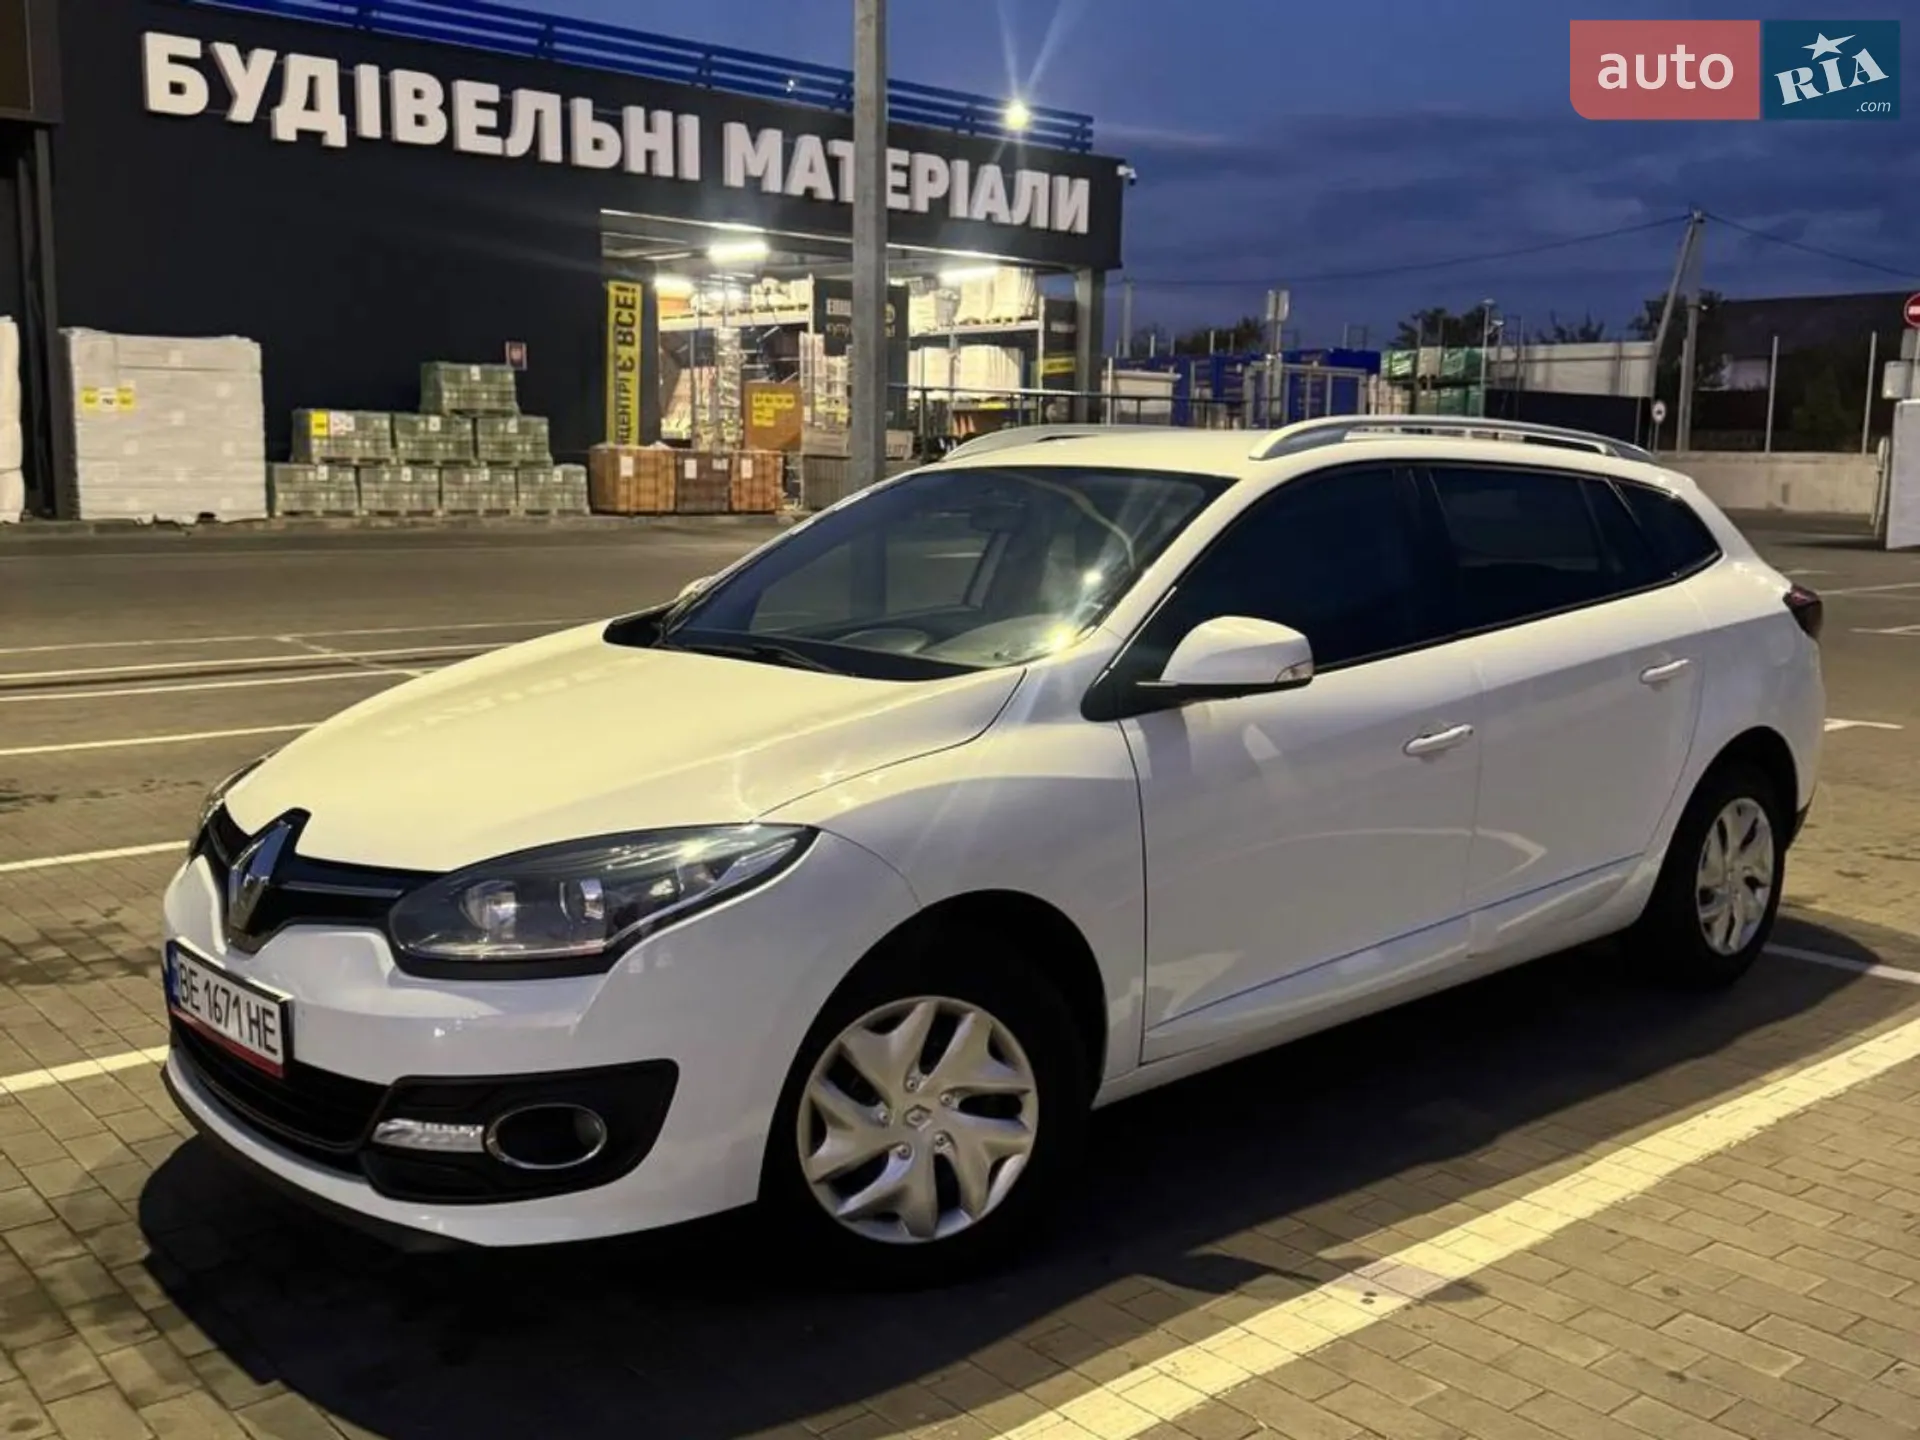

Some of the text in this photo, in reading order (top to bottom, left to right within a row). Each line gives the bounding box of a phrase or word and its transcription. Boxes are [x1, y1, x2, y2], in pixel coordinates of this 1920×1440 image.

[142, 31, 1090, 235] БУДІВЕЛЬНІ МАТЕРІАЛИ
[614, 285, 636, 348] ВСЕ!
[180, 963, 201, 1012] BE
[204, 979, 243, 1039] 1671
[246, 1001, 278, 1056] HE
